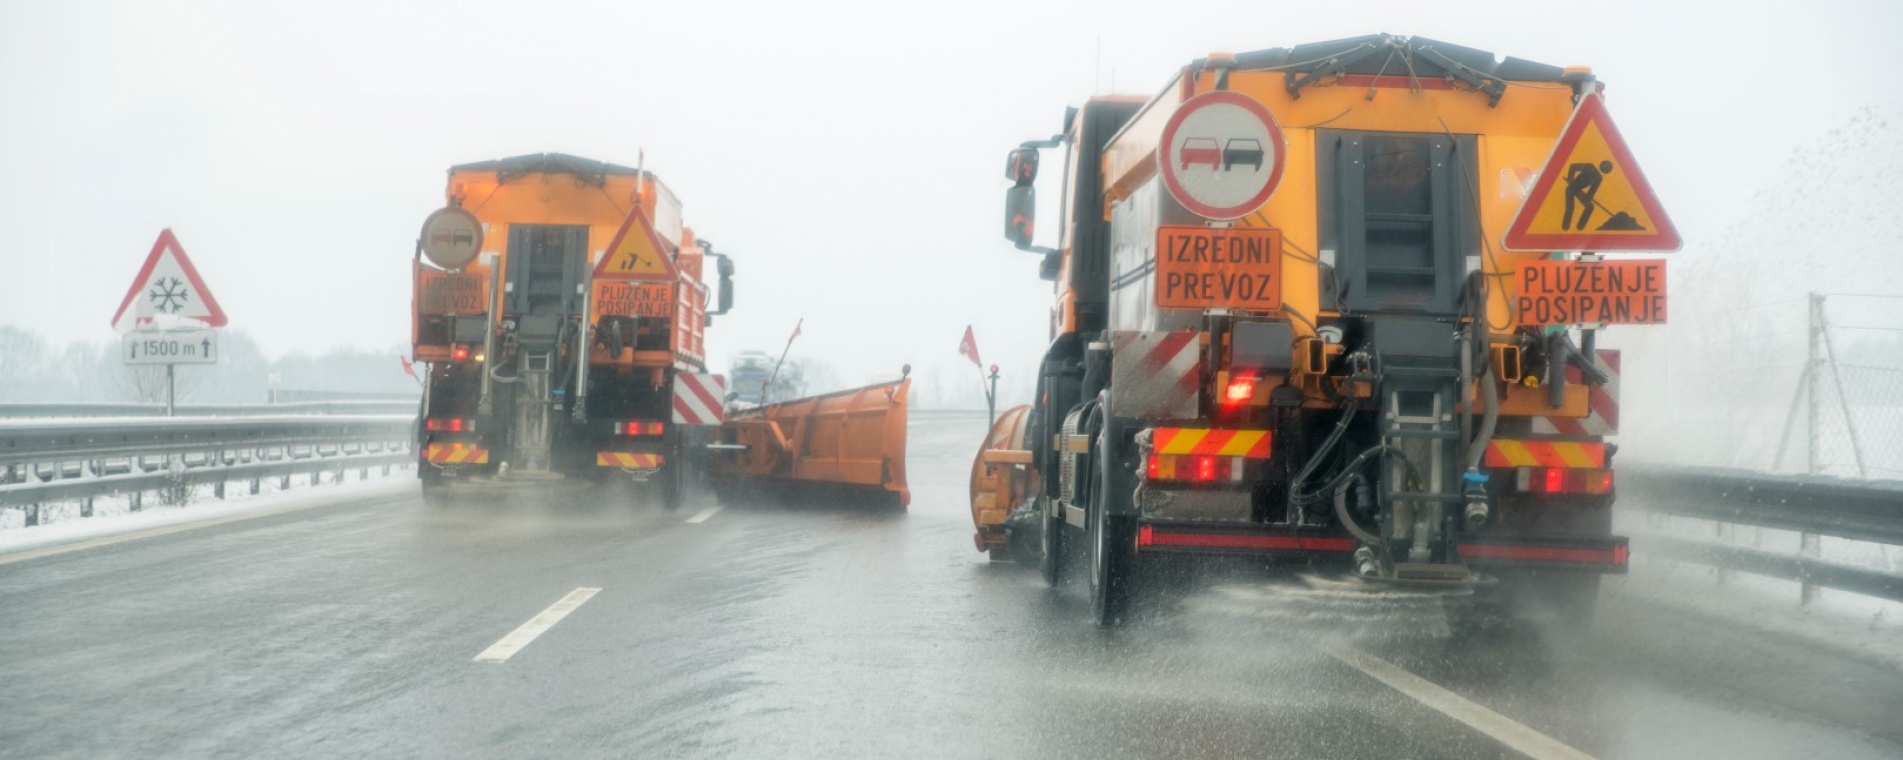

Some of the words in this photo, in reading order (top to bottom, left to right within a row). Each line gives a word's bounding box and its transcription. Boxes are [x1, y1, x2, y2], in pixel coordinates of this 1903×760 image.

[1168, 235, 1271, 264] IZREDNI
[1166, 271, 1271, 302] PREVOZ
[1523, 265, 1658, 293] PLUZENJE
[597, 300, 670, 316] POSIPANJE
[1519, 296, 1665, 324] POSIPANJE
[143, 341, 178, 356] 1500
[183, 344, 195, 355] m
